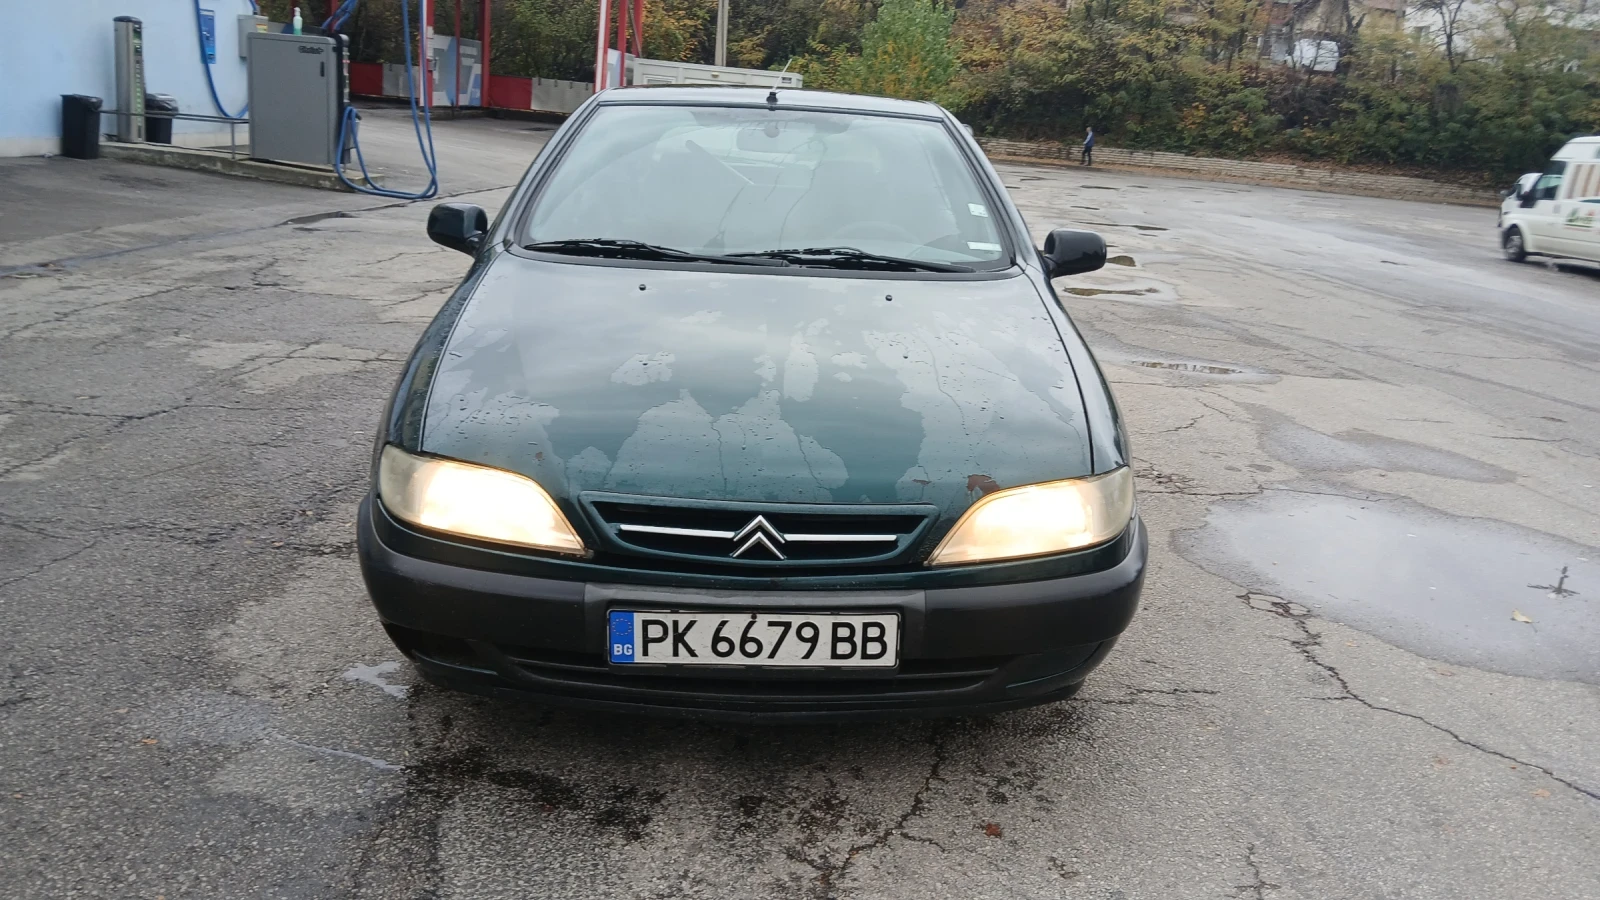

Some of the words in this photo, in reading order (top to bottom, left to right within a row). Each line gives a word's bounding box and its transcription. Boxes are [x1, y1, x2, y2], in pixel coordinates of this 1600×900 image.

[613, 643, 633, 656] BG
[641, 619, 699, 658] PK
[711, 620, 820, 660] 6679
[831, 622, 888, 660] BB
